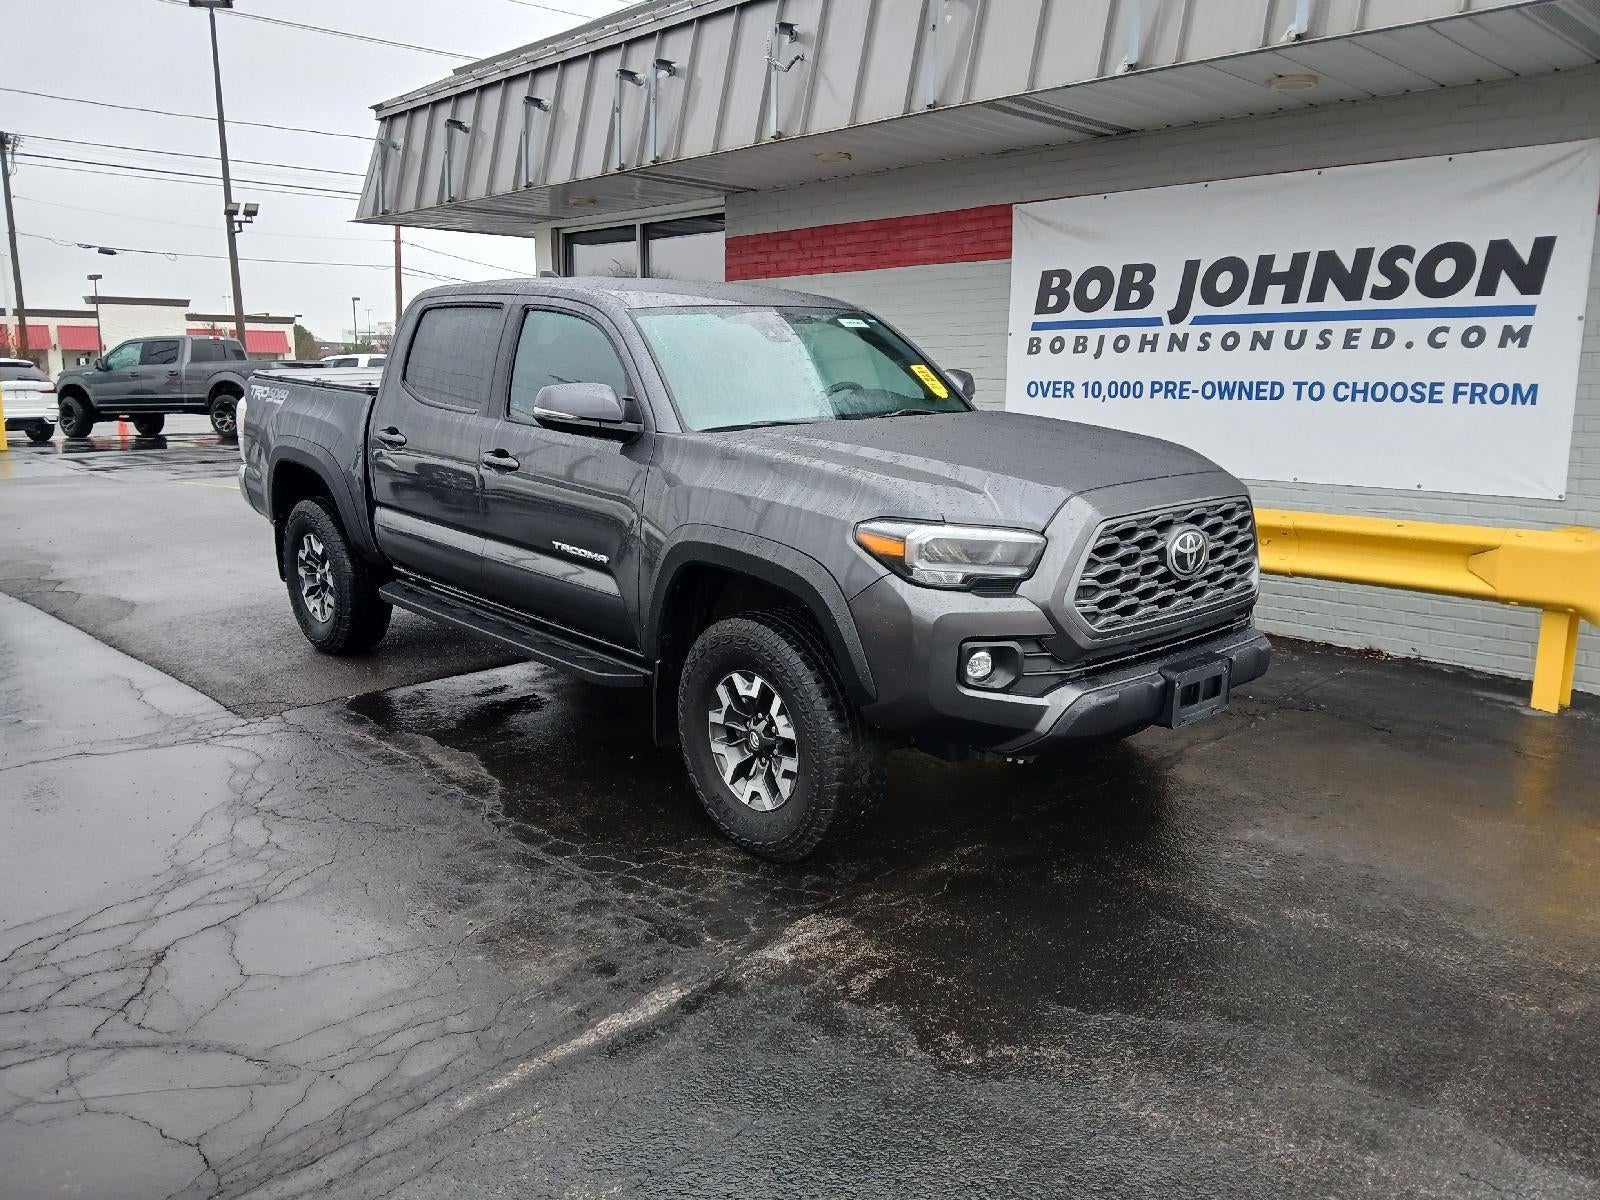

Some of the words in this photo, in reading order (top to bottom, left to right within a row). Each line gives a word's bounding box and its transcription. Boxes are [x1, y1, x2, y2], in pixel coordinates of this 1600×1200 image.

[1034, 263, 1156, 315] BOB
[1167, 236, 1557, 325] JOHNSON
[1027, 325, 1533, 359] BOBJOHNSONUSED.COM
[1026, 380, 1075, 399] OVER
[1081, 380, 1144, 402] 10,000
[1149, 380, 1285, 401] PRE-OWNED
[1292, 381, 1326, 402] TO
[1333, 381, 1446, 404] CHOOSE
[1452, 382, 1539, 406] FROM
[551, 540, 609, 563] TACOMA
